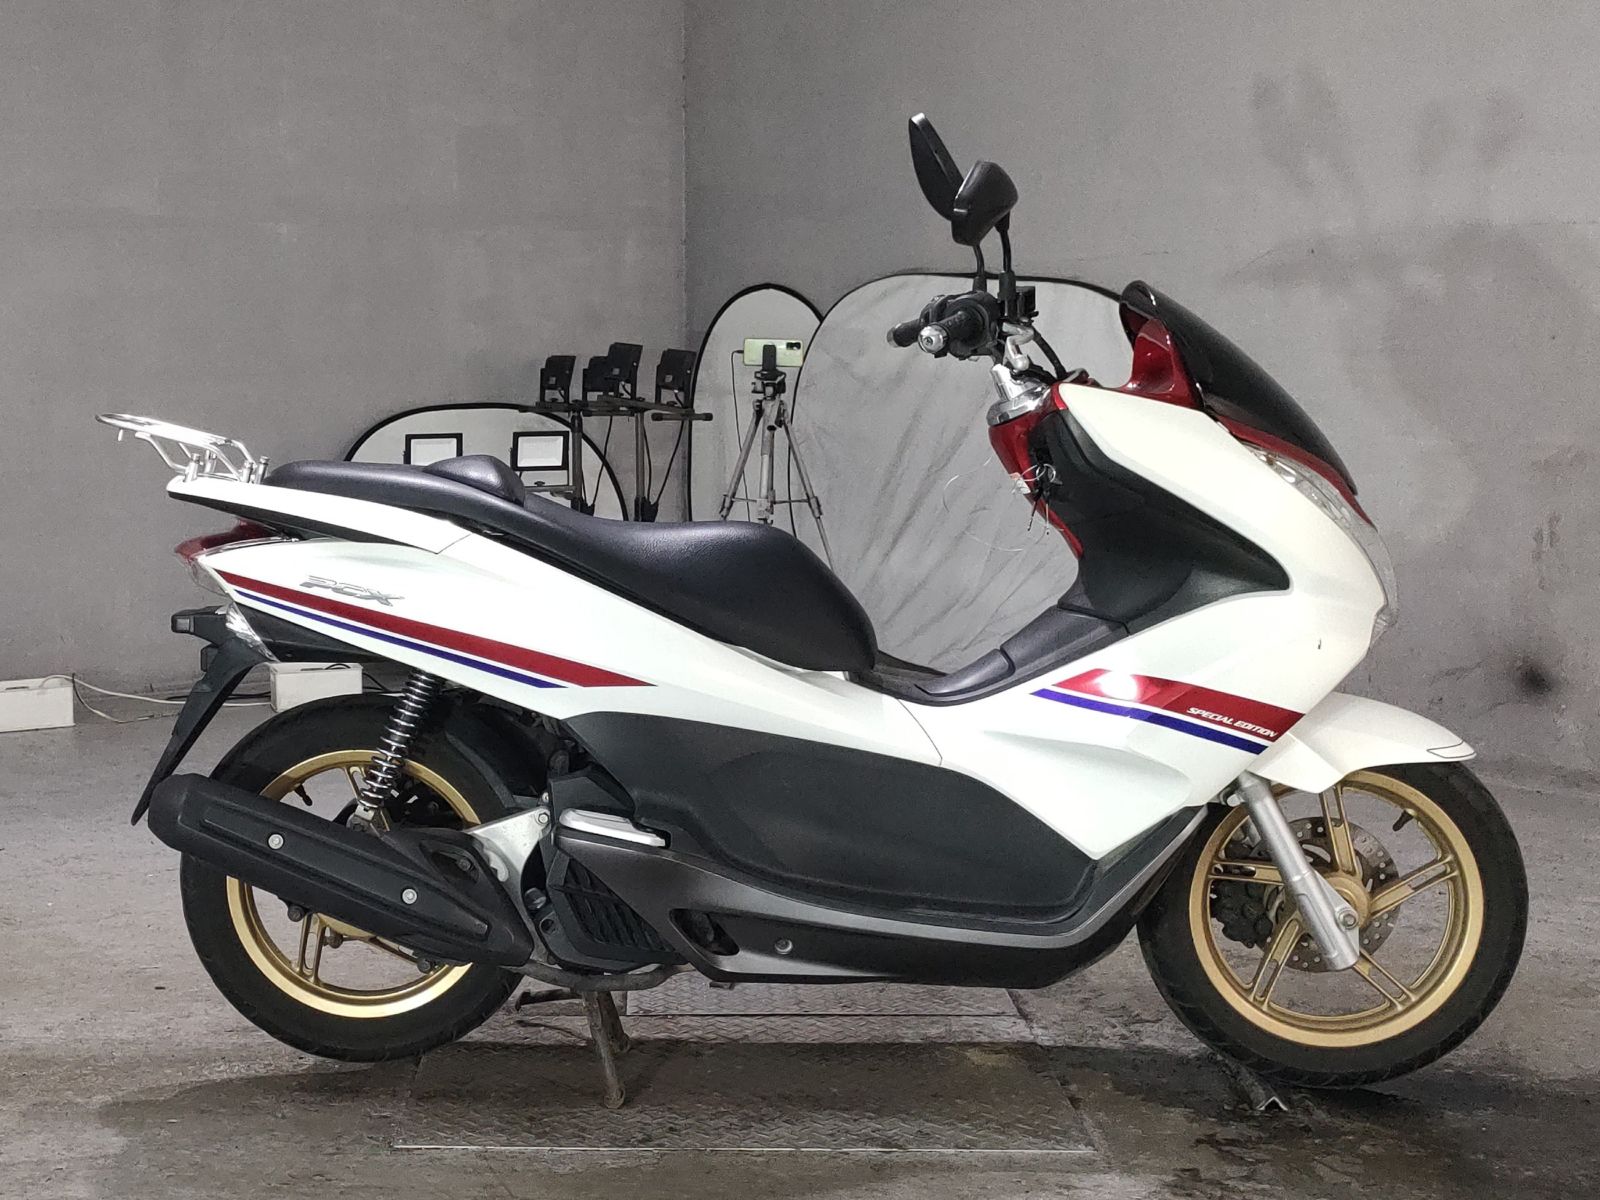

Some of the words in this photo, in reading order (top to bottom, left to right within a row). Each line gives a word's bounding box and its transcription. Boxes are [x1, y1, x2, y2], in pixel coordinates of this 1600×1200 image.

[300, 575, 404, 606] PCX
[1187, 707, 1234, 724] SPECIAL
[1234, 720, 1277, 737] EDITION
